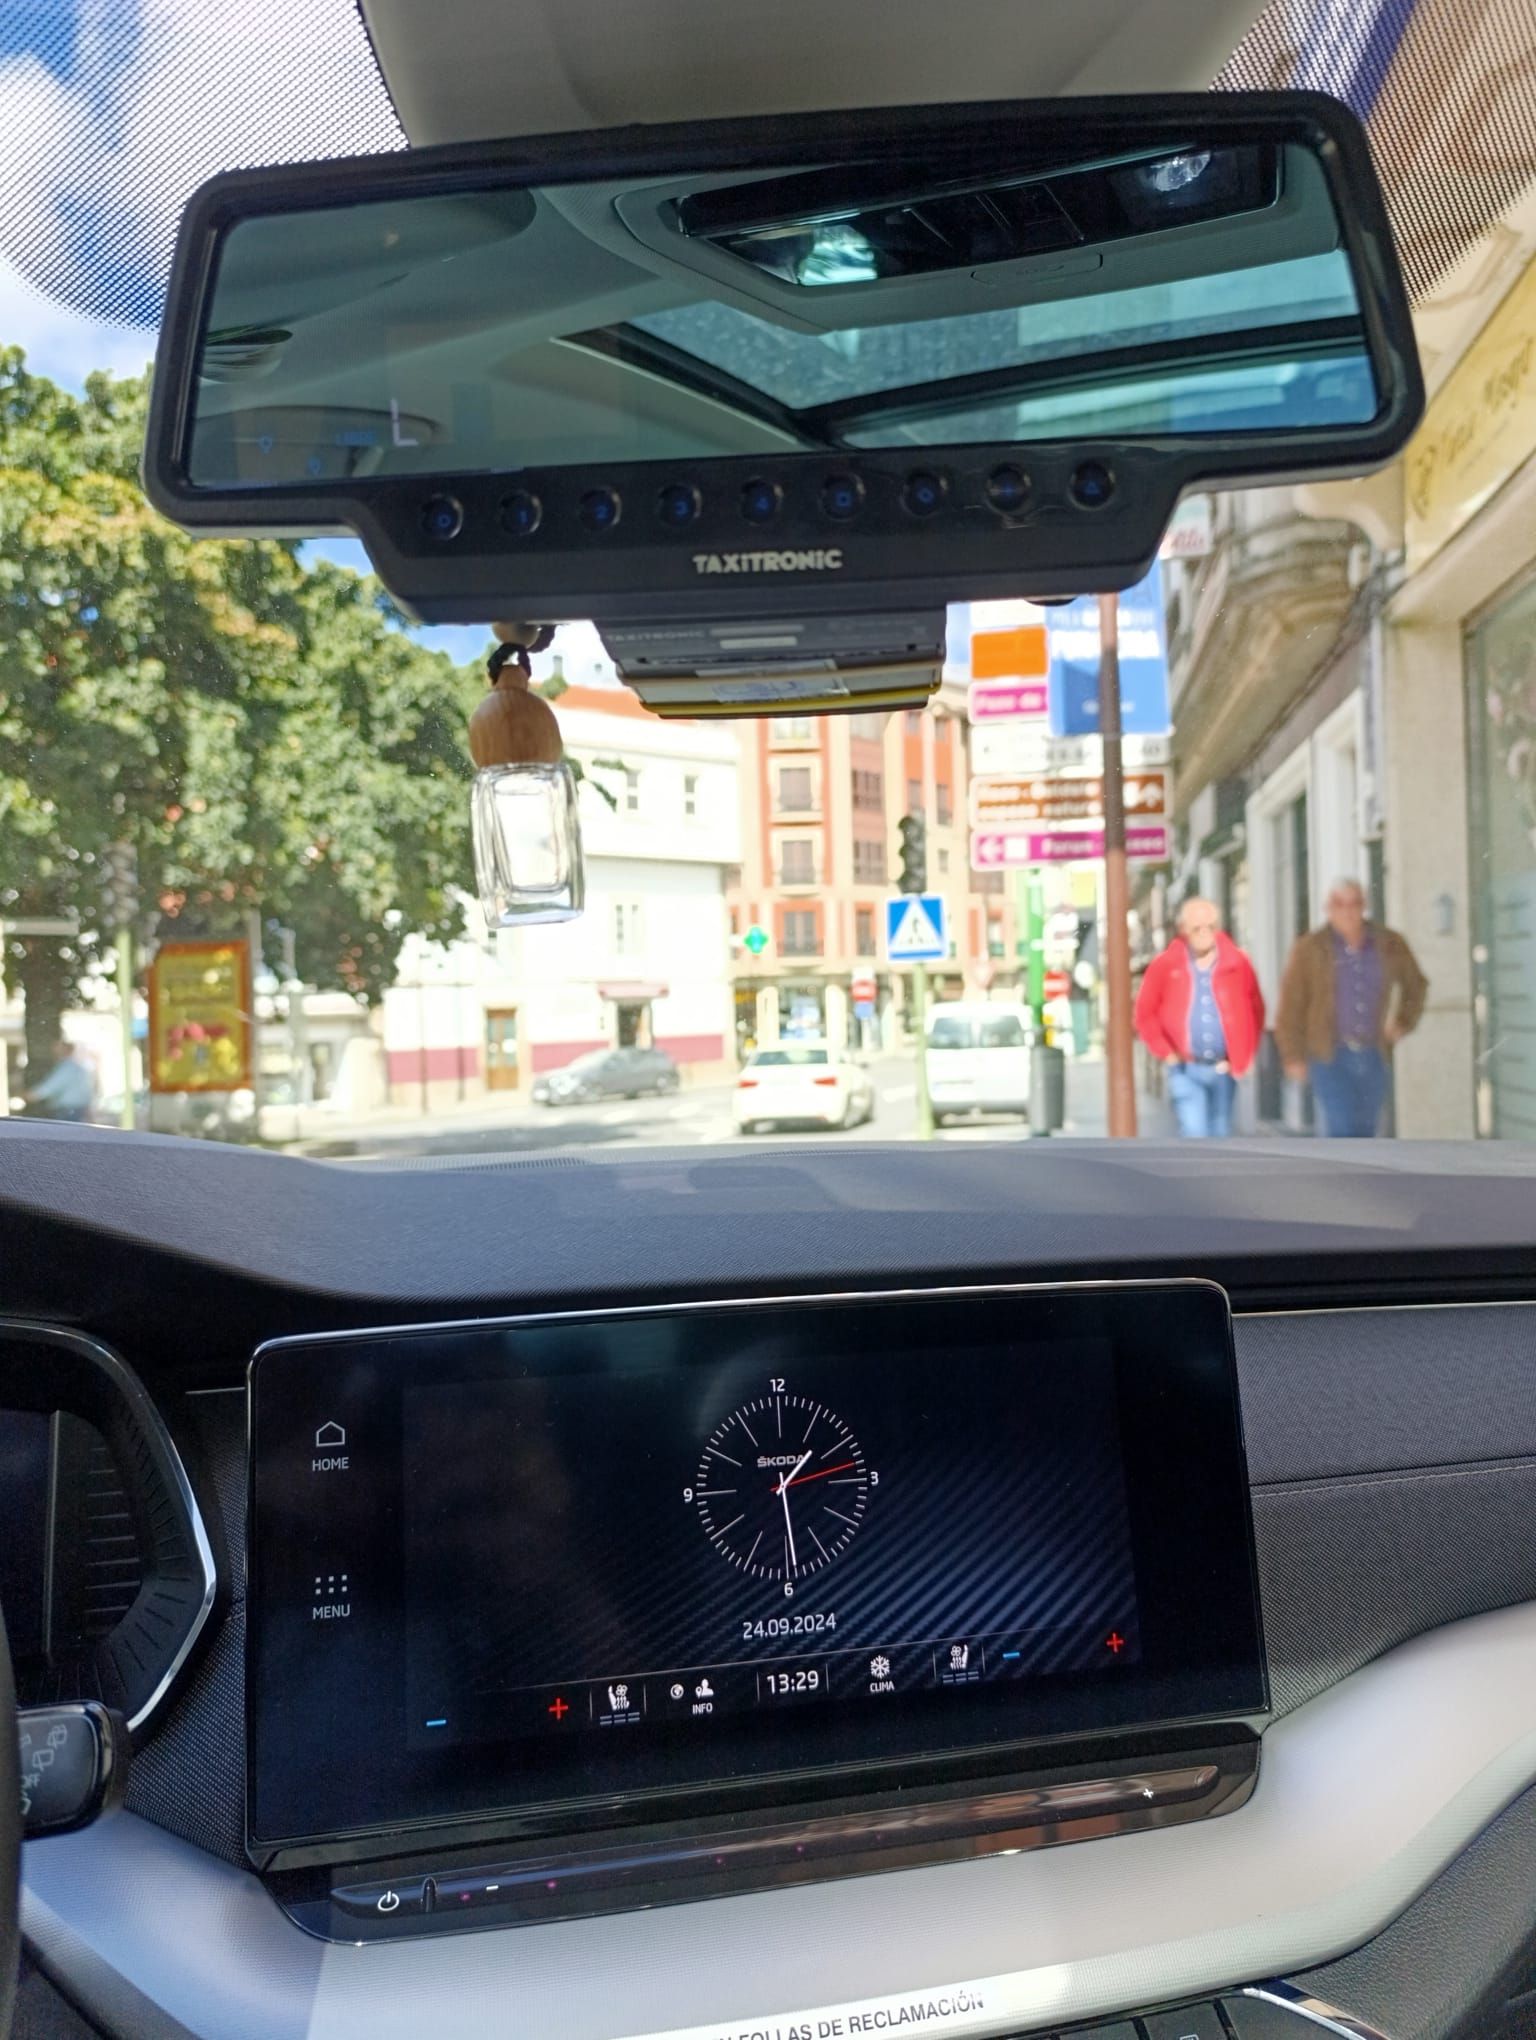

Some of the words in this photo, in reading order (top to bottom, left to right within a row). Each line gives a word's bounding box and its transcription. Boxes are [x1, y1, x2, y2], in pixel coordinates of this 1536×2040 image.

[769, 1378, 786, 1392] 12
[312, 1456, 350, 1472] HOME
[870, 1471, 879, 1484] 3
[683, 1488, 693, 1502] 9
[784, 1582, 794, 1597] 6
[312, 1603, 351, 1620] MENU
[742, 1612, 837, 1640] 24.09.2024
[766, 1670, 820, 1695] 13:29
[869, 1680, 895, 1693] CLIMA
[691, 1702, 714, 1716] INFO
[817, 2018, 844, 2039] DE
[848, 1989, 984, 2034] RECLAMACIÓN
